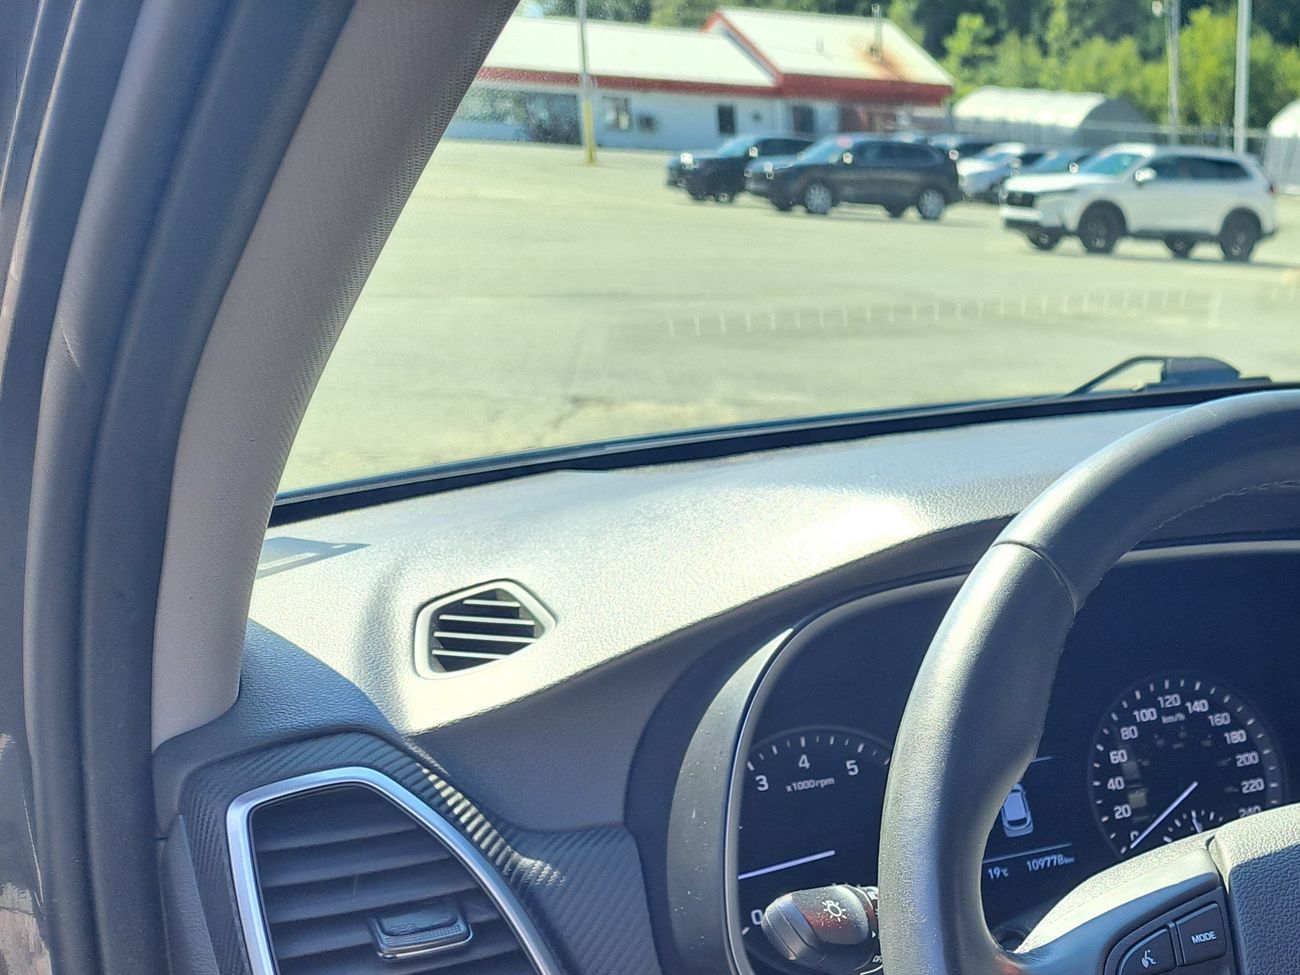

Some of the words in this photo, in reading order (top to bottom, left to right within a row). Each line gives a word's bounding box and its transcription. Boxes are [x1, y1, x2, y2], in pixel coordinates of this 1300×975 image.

[1157, 693, 1181, 708] 120
[1185, 699, 1209, 714] 140
[1133, 708, 1157, 723] 100
[1161, 712, 1185, 724] km/h
[1208, 712, 1231, 727] 160
[1120, 725, 1138, 740] 80
[1223, 729, 1247, 744] 180
[798, 754, 810, 770] 4
[1109, 749, 1128, 764] 60
[1235, 752, 1260, 767] 200
[845, 759, 859, 776] 5
[755, 774, 769, 792] 3
[1106, 776, 1125, 791] 40
[1241, 778, 1265, 794] 220
[1113, 804, 1132, 819] 20
[1191, 930, 1217, 945] MODE
